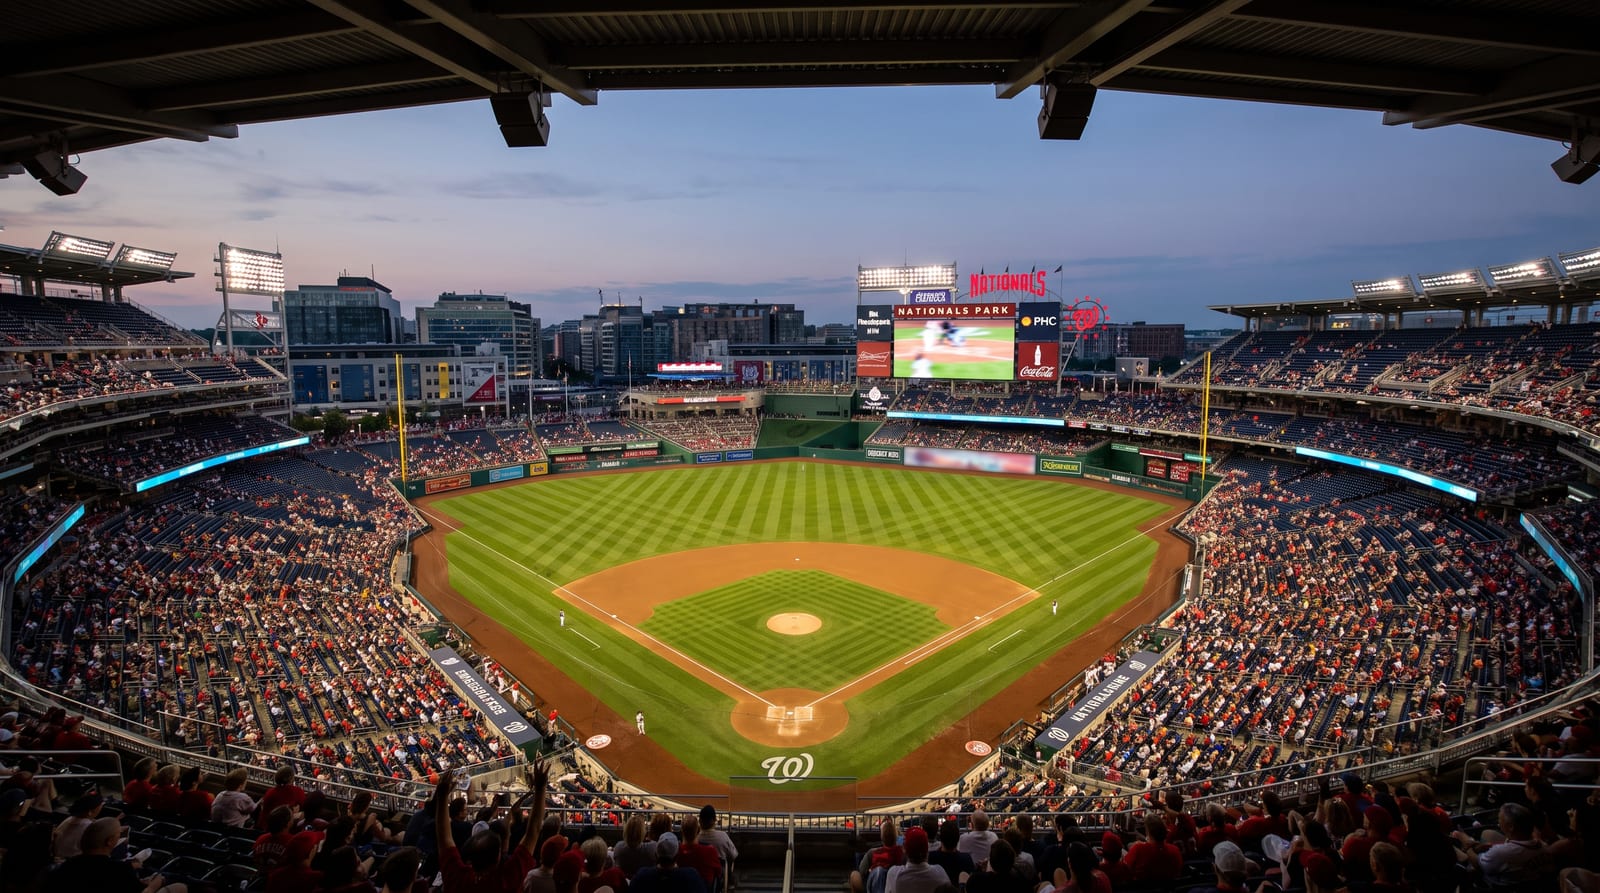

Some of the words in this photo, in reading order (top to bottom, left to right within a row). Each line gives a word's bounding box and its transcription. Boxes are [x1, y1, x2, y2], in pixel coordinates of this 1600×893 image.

[970, 270, 1047, 298] NATIONALS
[898, 307, 969, 316] NATIONALS
[975, 306, 1009, 315] PARK
[1033, 316, 1057, 326] PHC
